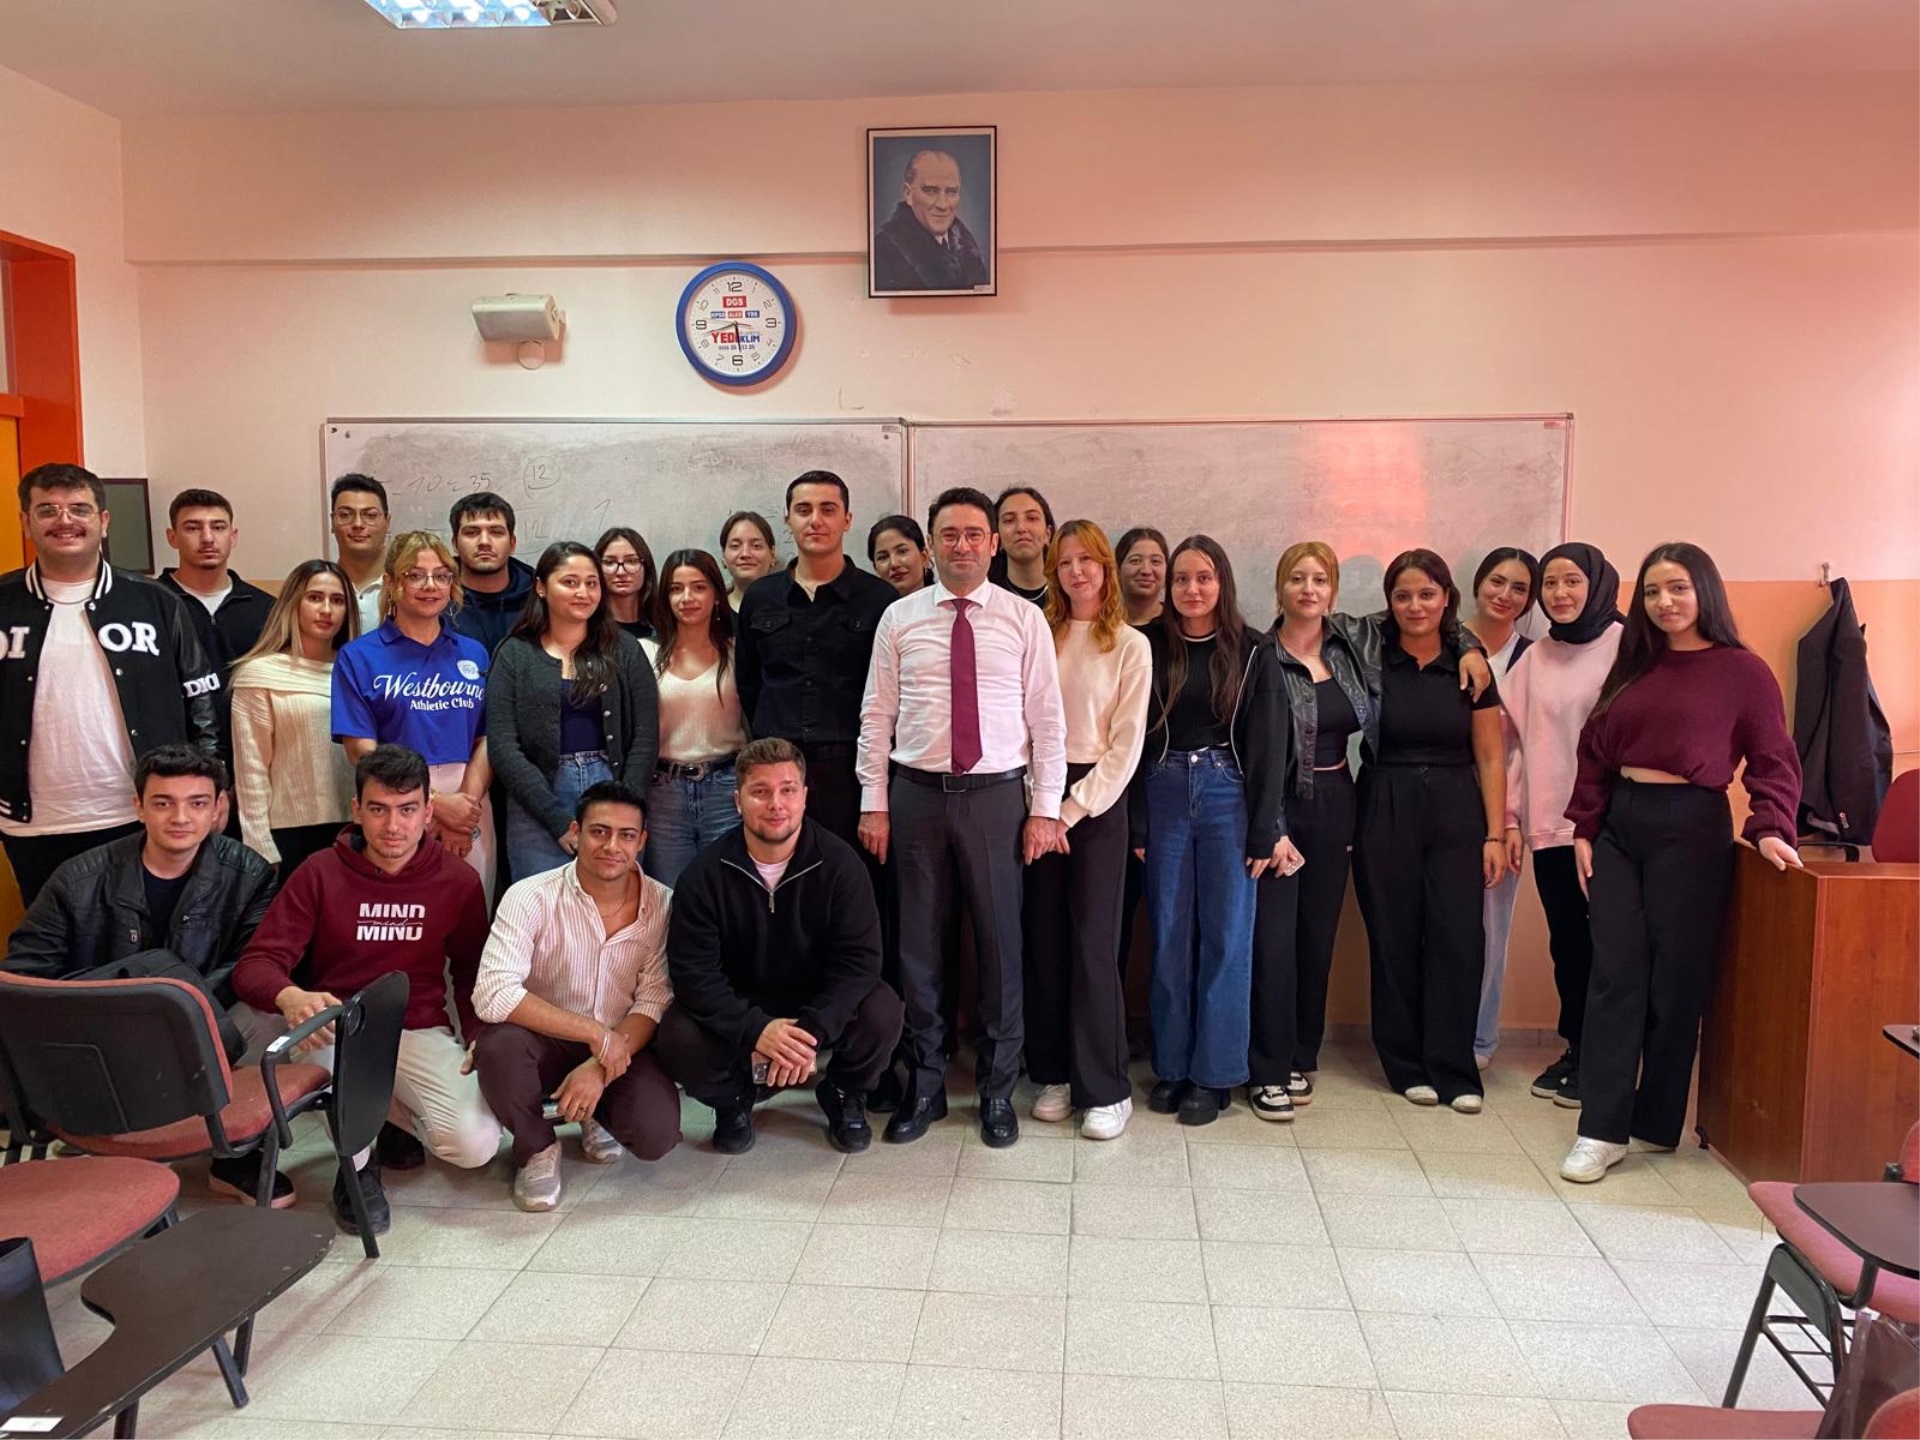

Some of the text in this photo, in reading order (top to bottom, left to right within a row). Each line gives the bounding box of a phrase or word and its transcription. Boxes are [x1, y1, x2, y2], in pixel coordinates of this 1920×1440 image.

[727, 281, 742, 292] 12
[726, 298, 744, 306] DGS
[695, 319, 707, 330] 9
[765, 317, 777, 328] 3
[732, 354, 744, 366] 6
[532, 463, 552, 481] 12
[98, 621, 160, 657] OR
[410, 697, 475, 711] Athletic Club
[359, 902, 426, 919] MIND
[356, 925, 423, 941] MIND
